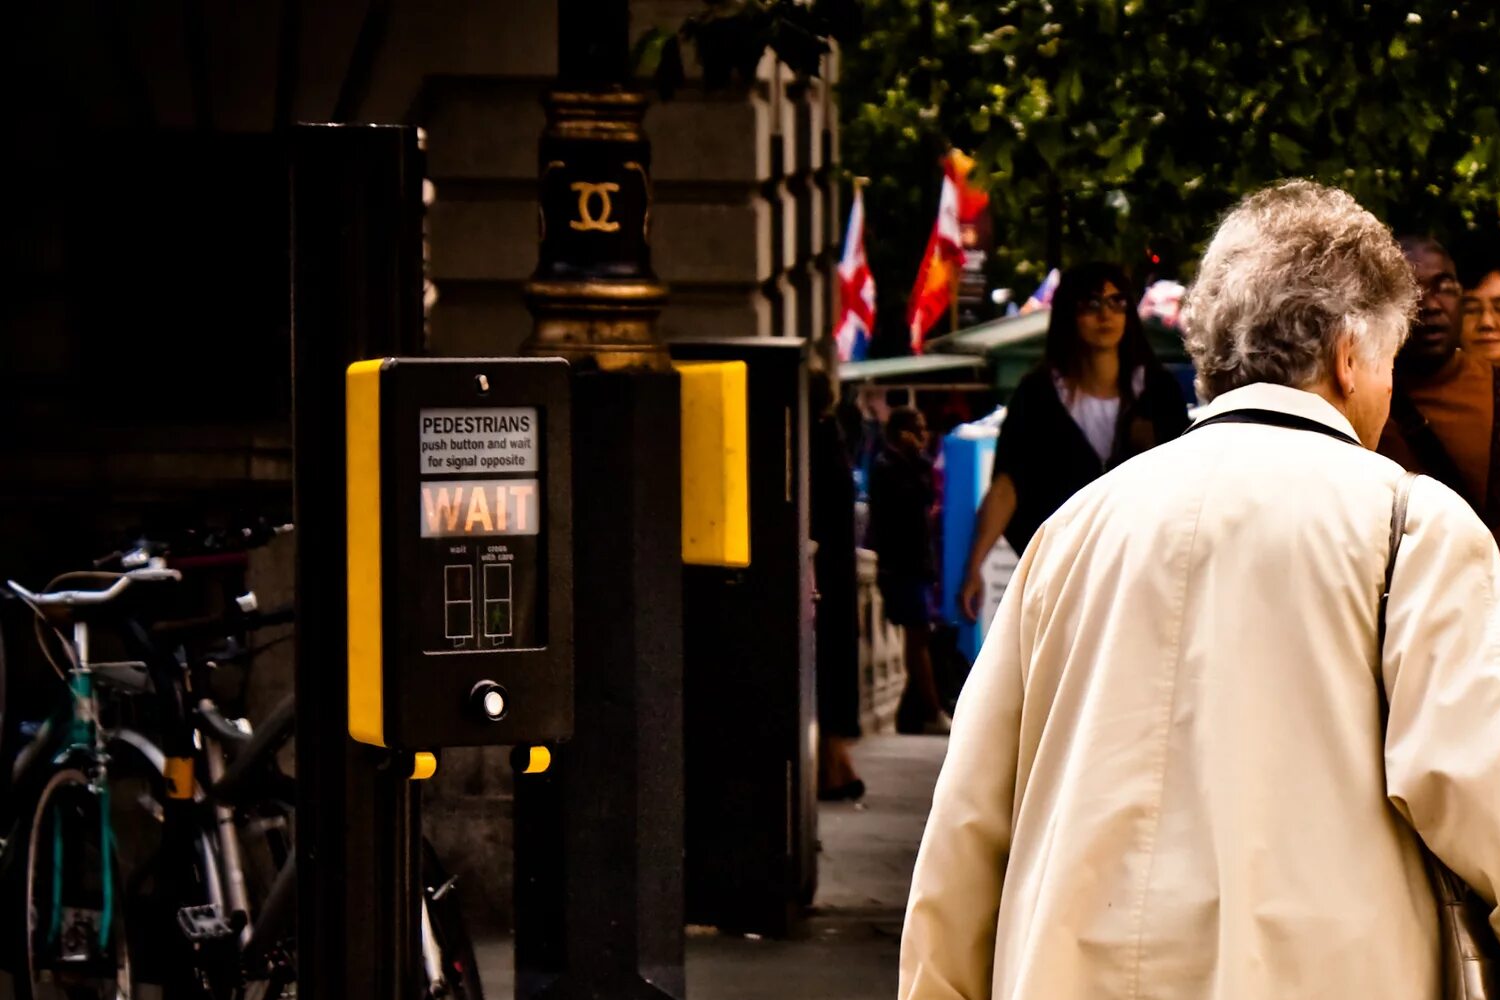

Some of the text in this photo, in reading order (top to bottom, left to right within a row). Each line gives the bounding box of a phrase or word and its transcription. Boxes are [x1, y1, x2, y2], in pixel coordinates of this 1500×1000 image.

[422, 415, 531, 434] PEDESTRIANS
[421, 437, 532, 453] push button and wait
[427, 453, 526, 470] for signal opposite
[422, 485, 535, 533] WAIT
